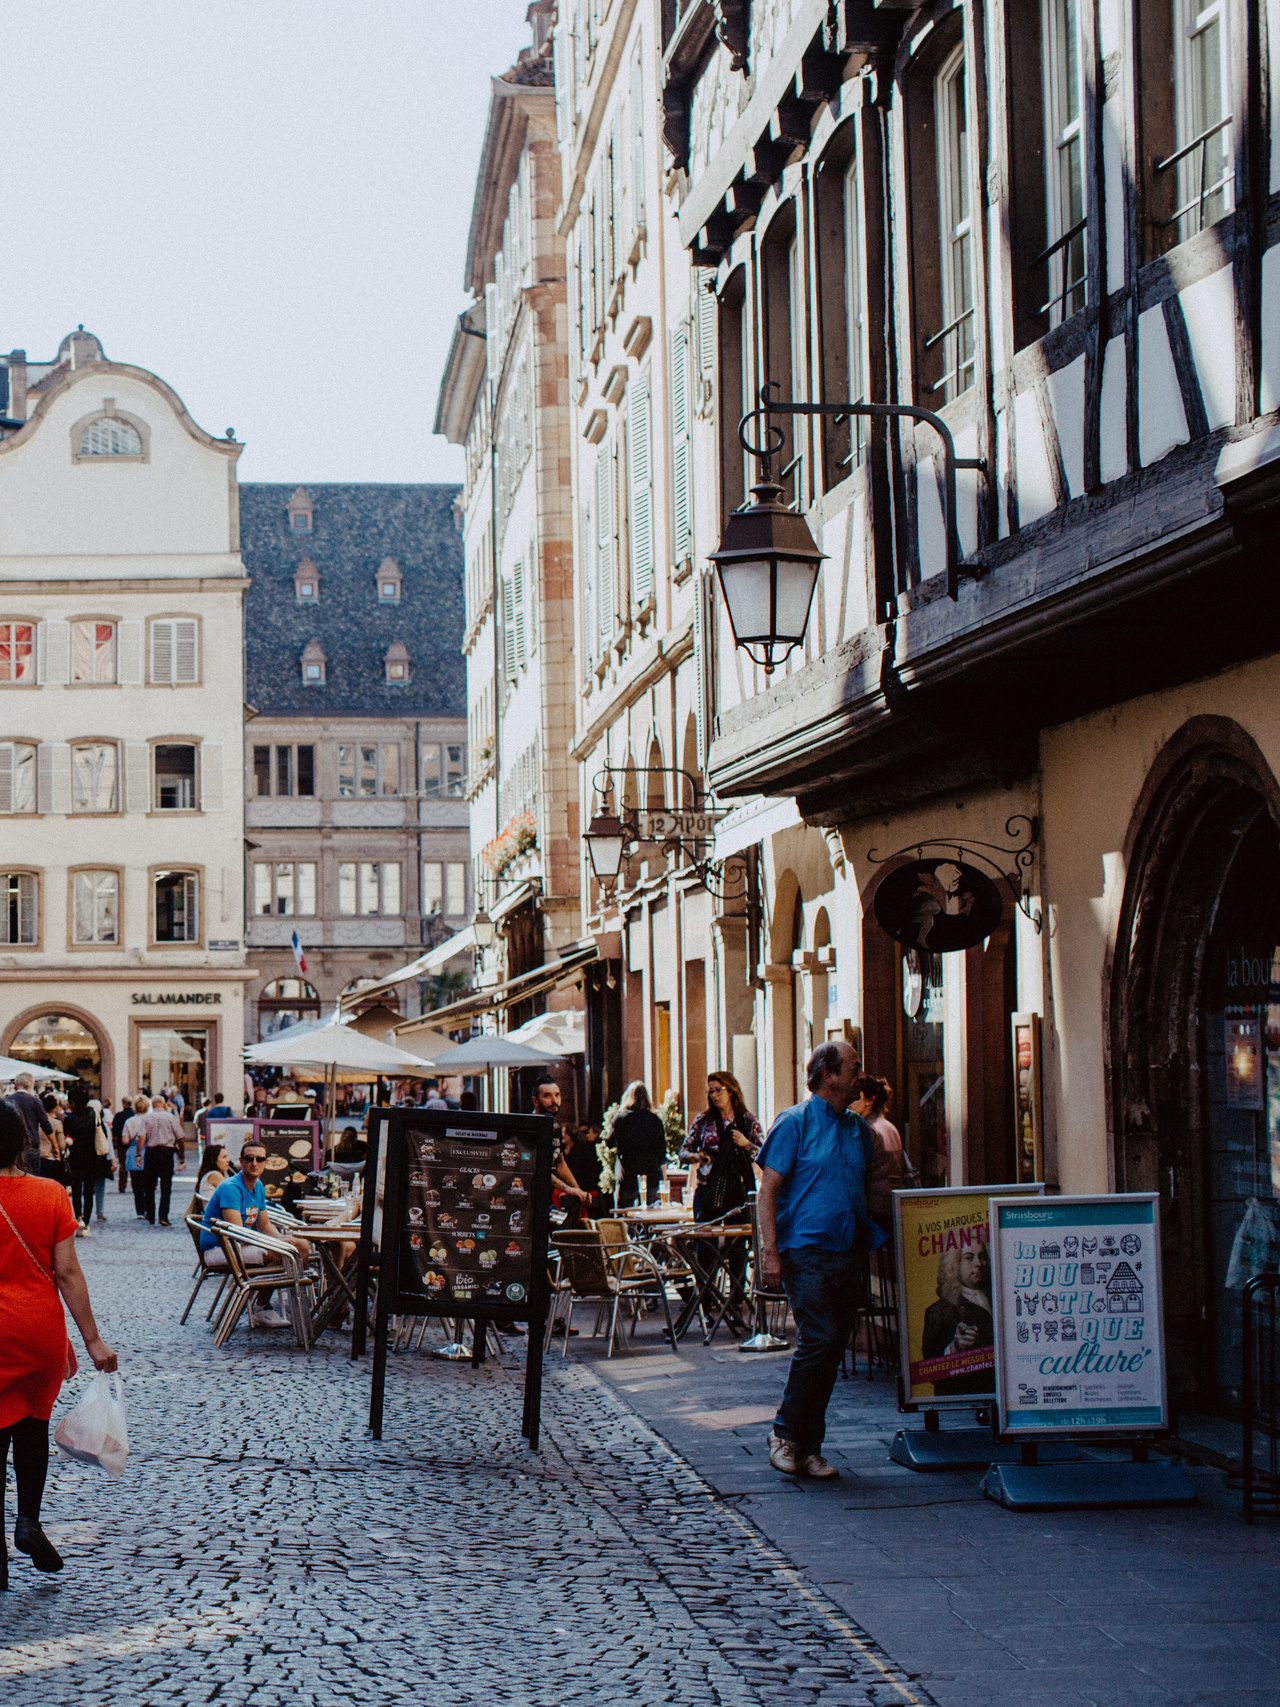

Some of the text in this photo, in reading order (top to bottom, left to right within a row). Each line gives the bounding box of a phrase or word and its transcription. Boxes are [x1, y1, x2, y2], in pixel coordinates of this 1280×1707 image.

[649, 817, 665, 832] 12
[131, 992, 222, 1005] SALAMANDER
[452, 1149, 489, 1157] EXCLUSIVITÉ
[459, 1166, 480, 1174] GLACES
[917, 1211, 985, 1235] À VOS MARQUES,
[1013, 1240, 1036, 1260] la
[455, 1273, 474, 1285] Bio
[1014, 1263, 1079, 1288] BOU
[1059, 1290, 1093, 1315] TI
[1080, 1316, 1145, 1345] QUE
[918, 1362, 950, 1376] CHANTEZ
[951, 1359, 960, 1369] LE
[960, 1353, 986, 1366] MESSIE
[1071, 1417, 1086, 1425] 12h
[1091, 1416, 1107, 1424] 19h
